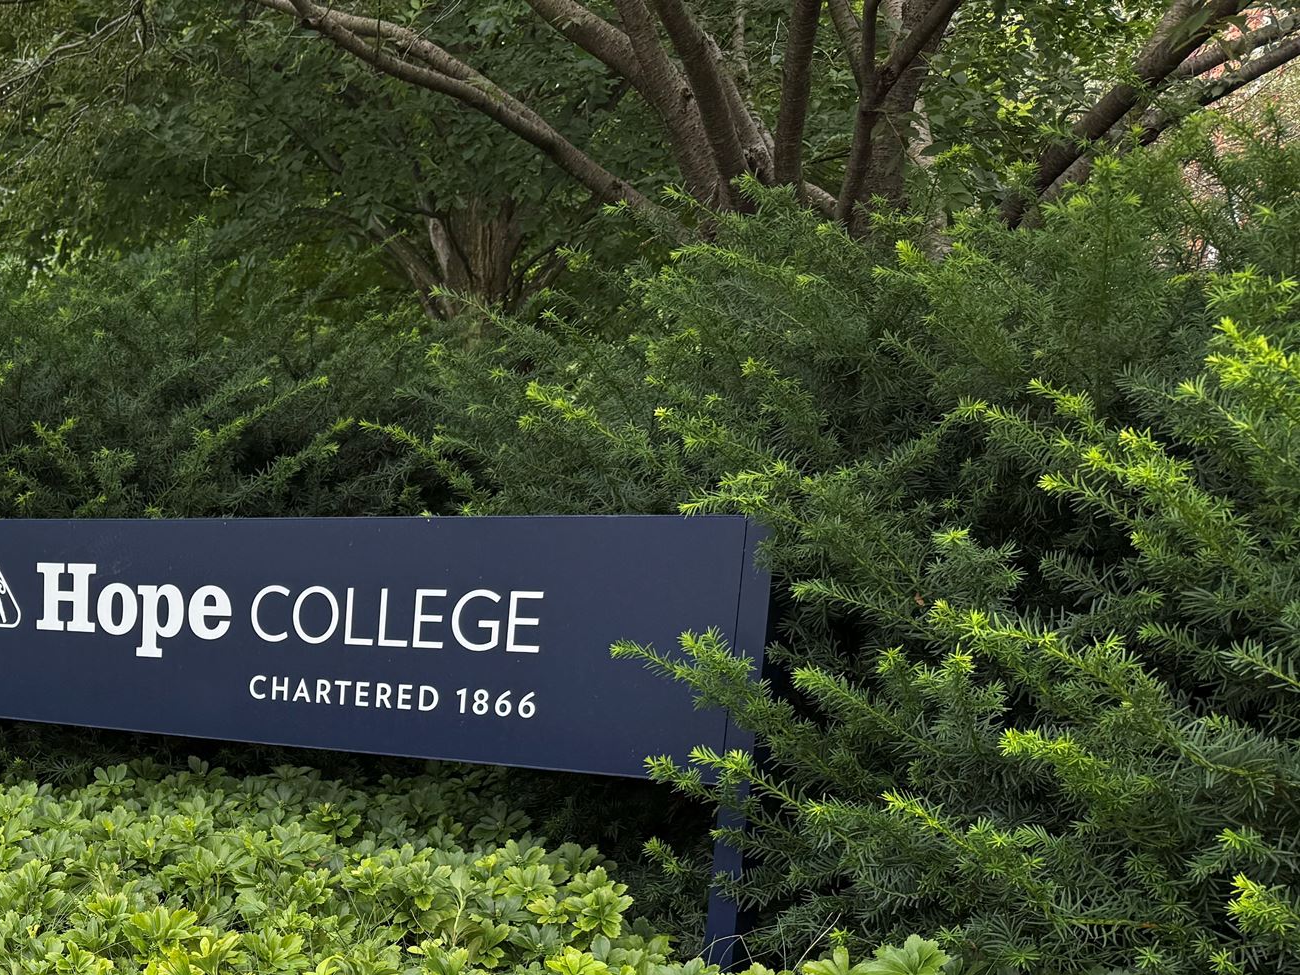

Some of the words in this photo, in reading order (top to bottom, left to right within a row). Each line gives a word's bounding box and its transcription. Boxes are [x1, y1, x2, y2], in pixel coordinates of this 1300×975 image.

[36, 562, 233, 658] Hope
[250, 584, 545, 654] COLLEGE
[248, 674, 439, 712] CHARTERED
[456, 687, 537, 719] 1866
